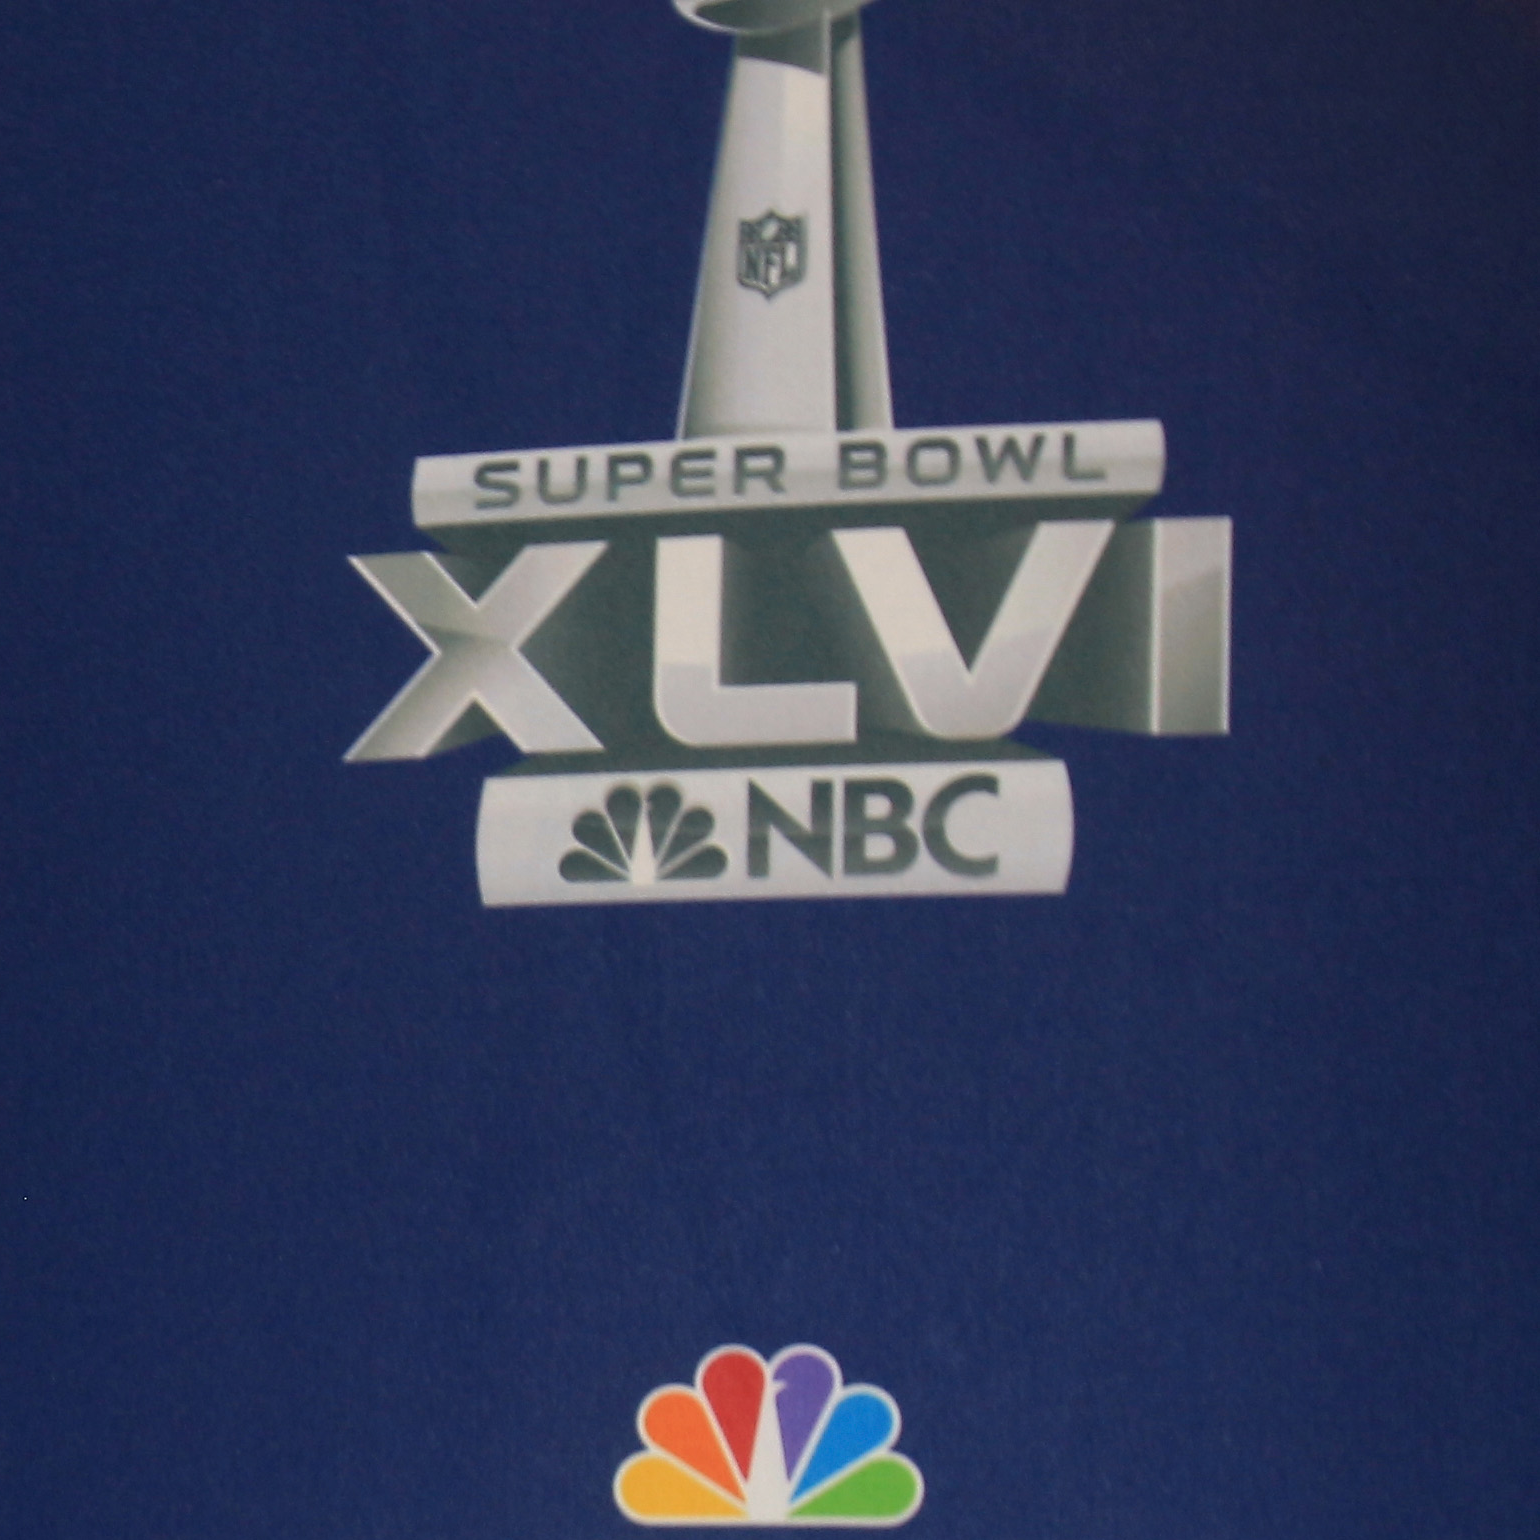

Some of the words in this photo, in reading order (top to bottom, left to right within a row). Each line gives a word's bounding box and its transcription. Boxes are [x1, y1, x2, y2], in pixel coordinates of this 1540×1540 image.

[473, 444, 786, 508] SUPER
[836, 433, 1106, 489] BOWL
[342, 517, 1233, 762] XLVI
[747, 773, 999, 879] NBC
